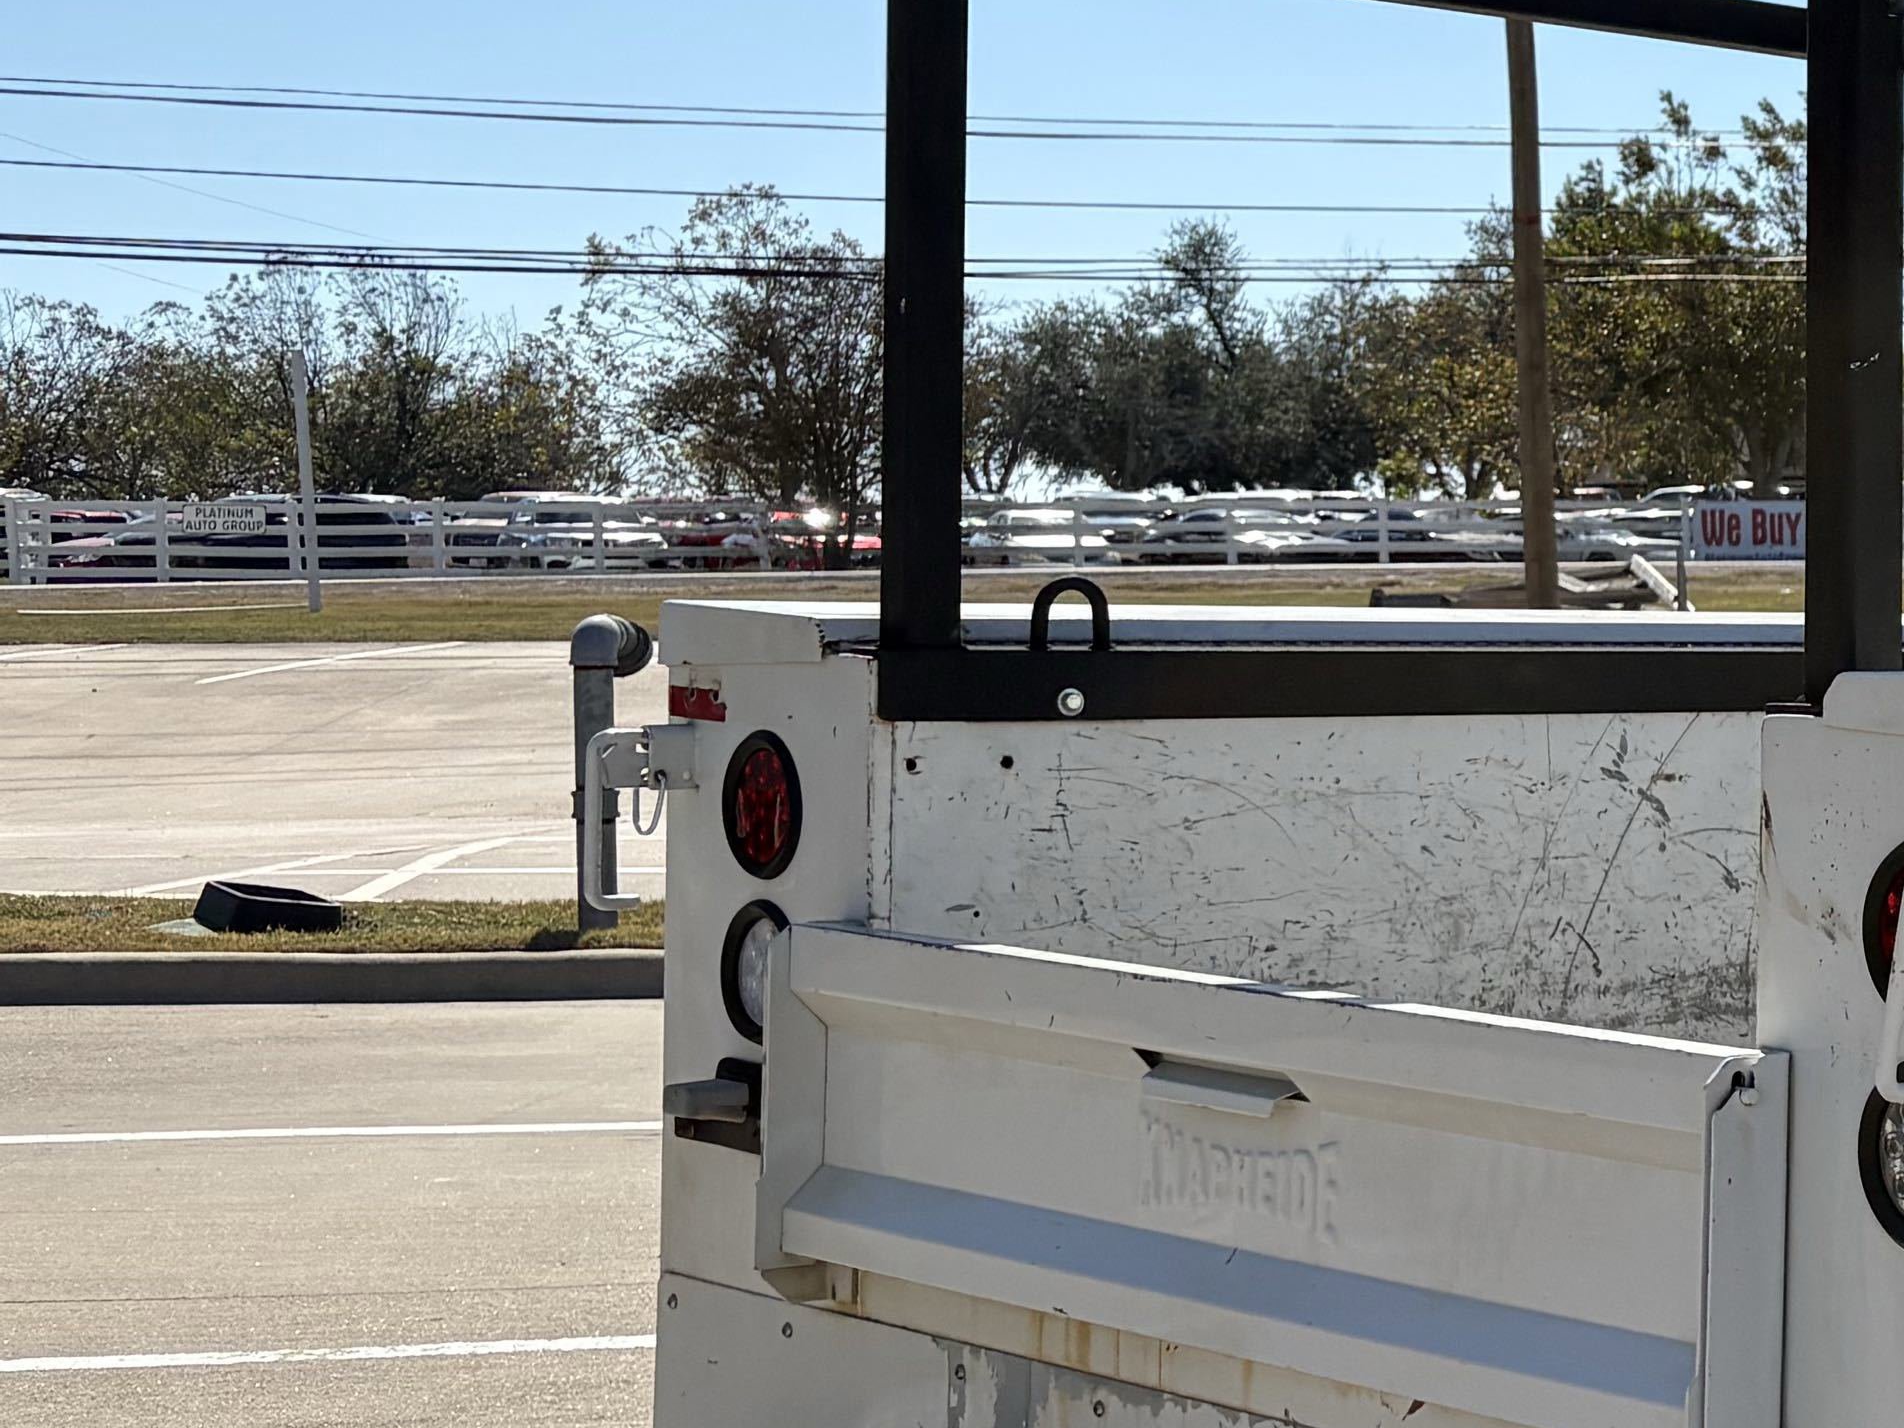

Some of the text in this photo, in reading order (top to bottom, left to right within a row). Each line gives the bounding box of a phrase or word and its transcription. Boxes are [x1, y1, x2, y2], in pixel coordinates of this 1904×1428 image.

[195, 507, 254, 519] PLATINUM
[185, 520, 264, 532] AUTO GROUP
[1701, 508, 1741, 547] We
